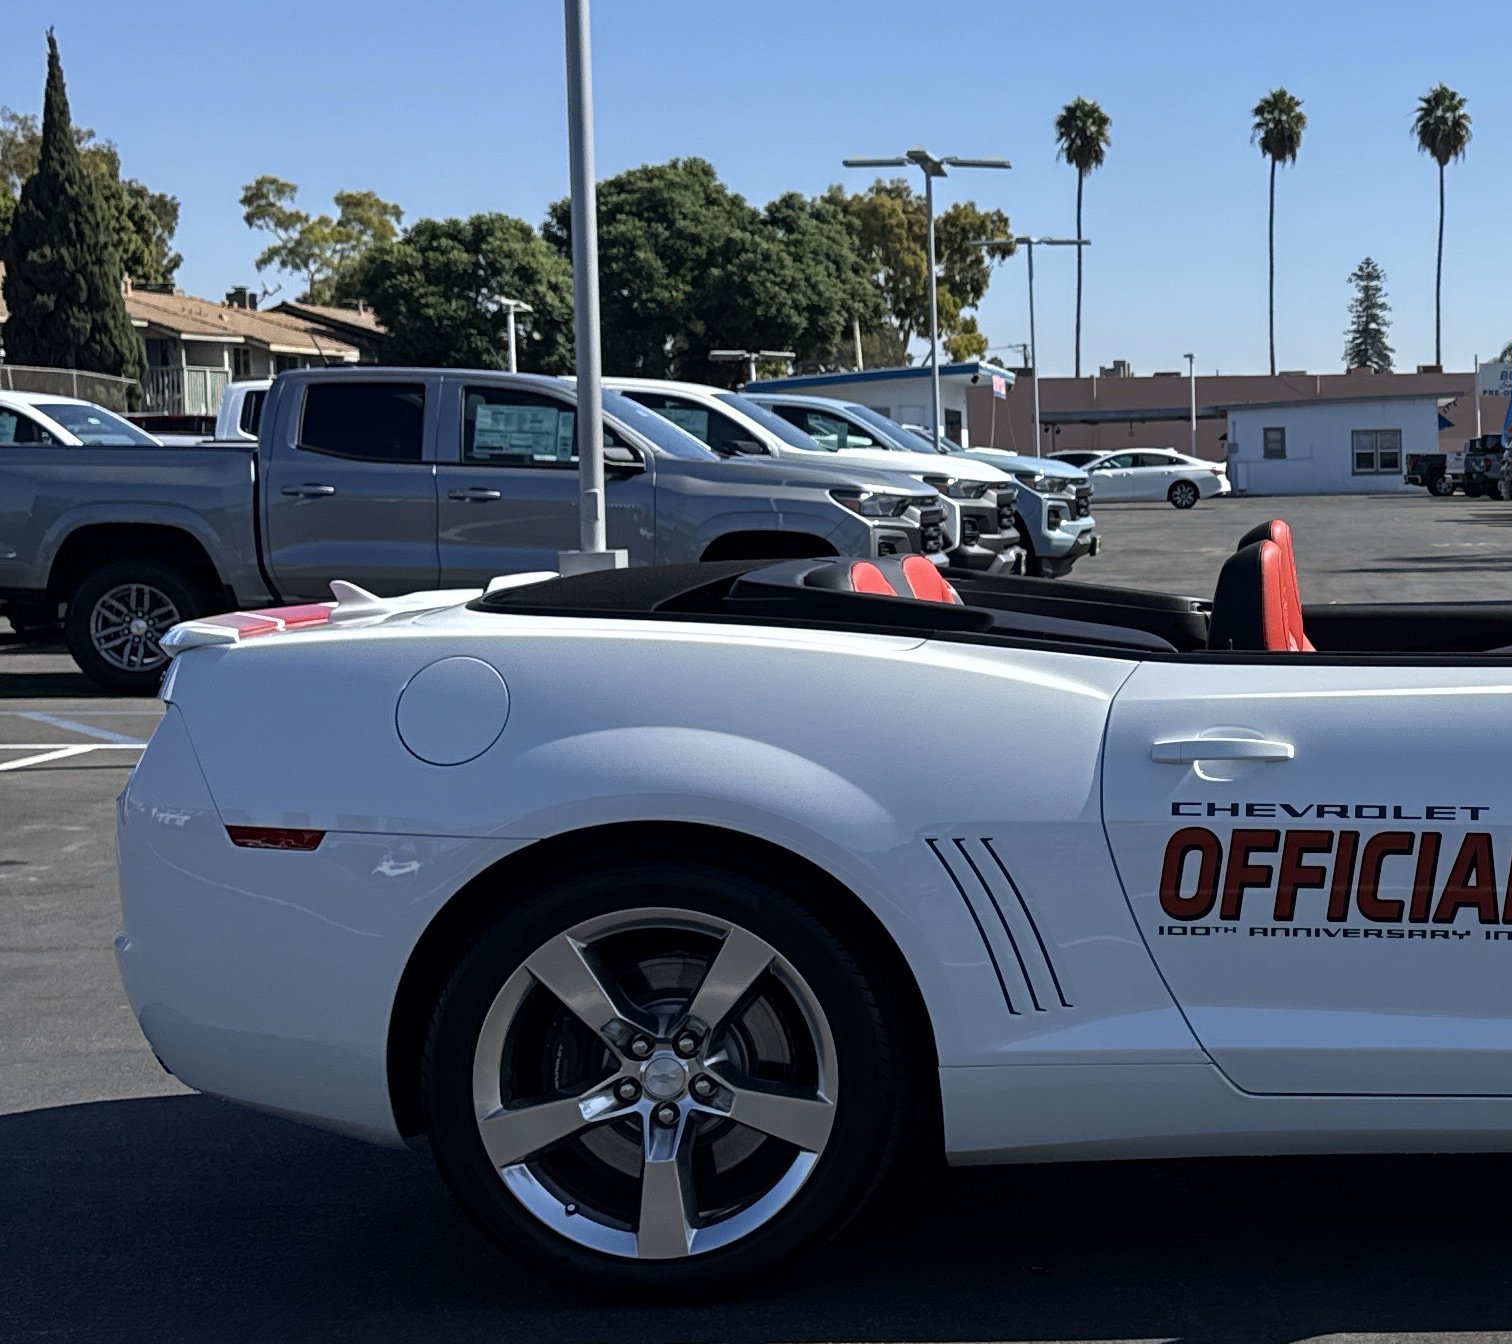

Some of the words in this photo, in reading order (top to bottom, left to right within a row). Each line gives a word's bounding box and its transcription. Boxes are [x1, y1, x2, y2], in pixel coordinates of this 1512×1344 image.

[1171, 802, 1490, 821] CHEVROLET
[1158, 925, 1237, 936] 100TH
[1249, 927, 1471, 940] ANNIVERSARY
